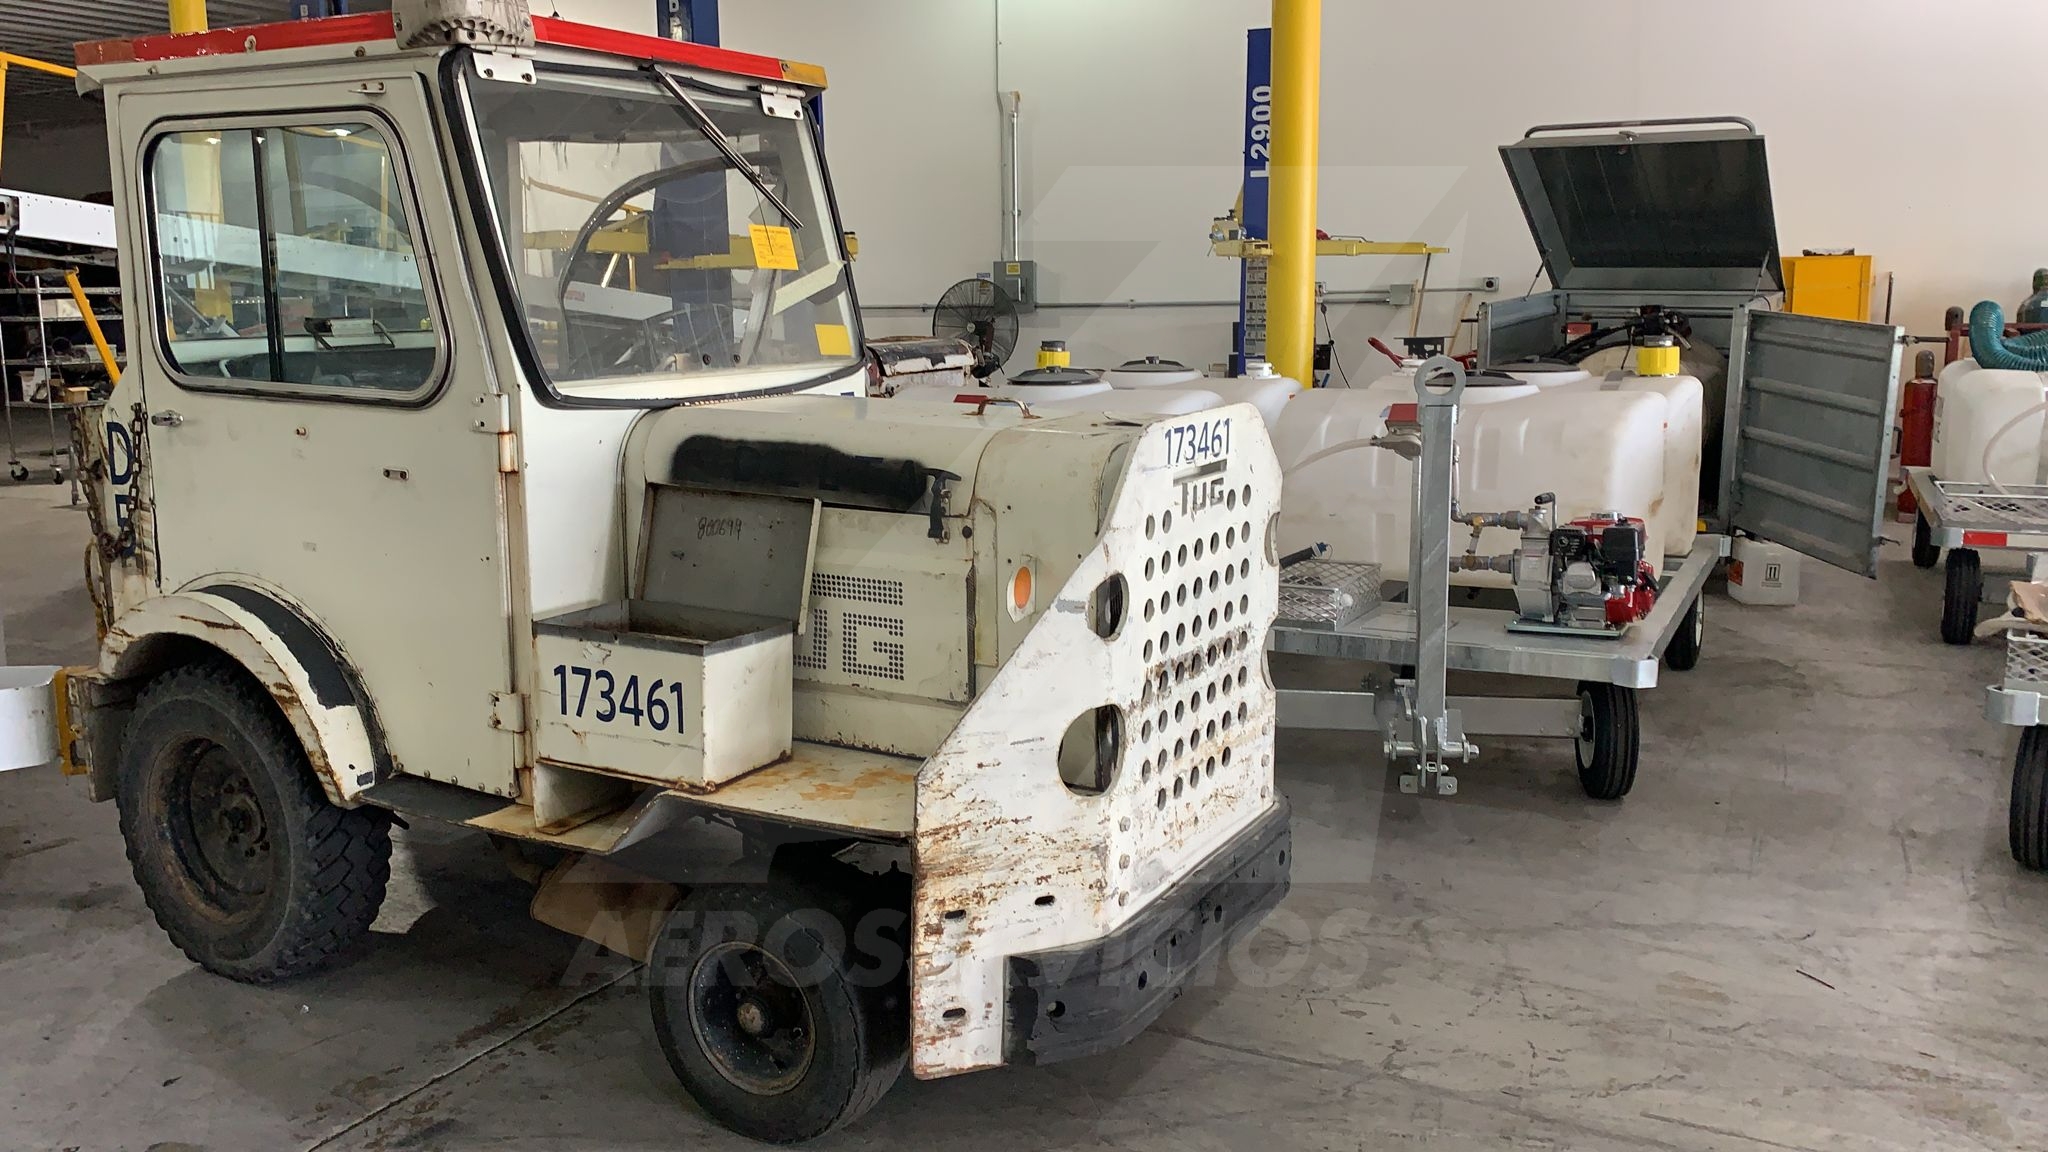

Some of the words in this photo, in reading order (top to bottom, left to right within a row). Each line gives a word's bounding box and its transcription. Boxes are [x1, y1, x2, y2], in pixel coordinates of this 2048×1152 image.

[1250, 85, 1271, 178] L2900
[1165, 418, 1230, 465] 173461
[553, 664, 684, 734] 173461
